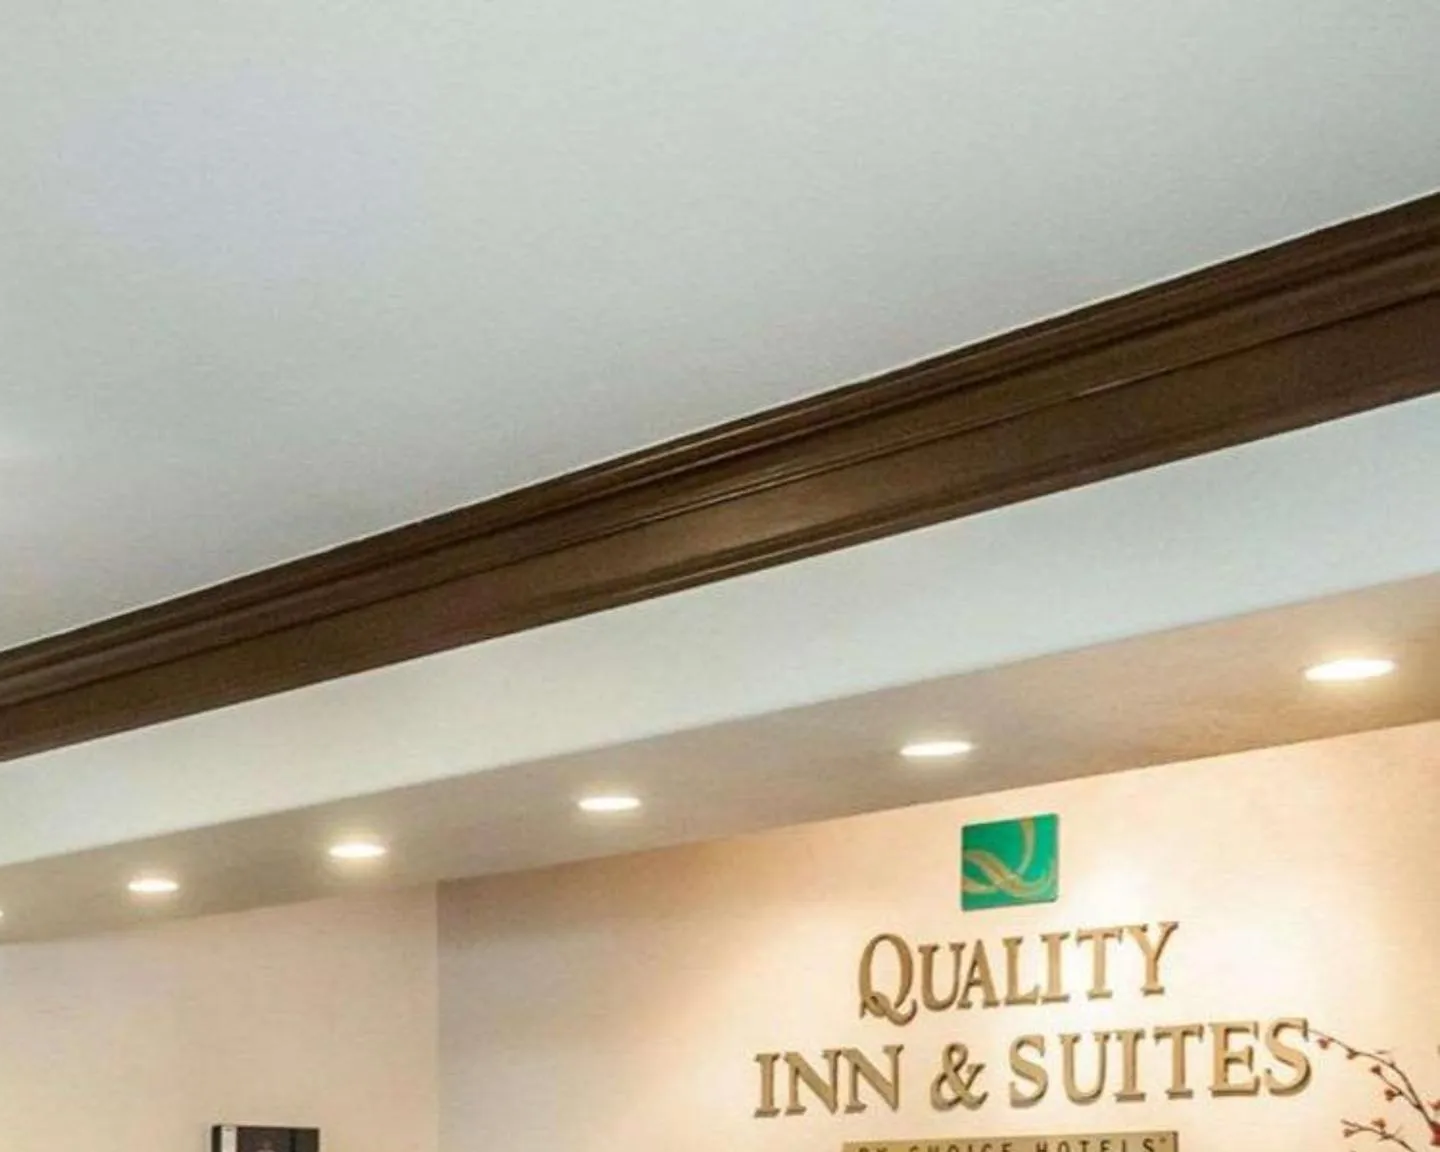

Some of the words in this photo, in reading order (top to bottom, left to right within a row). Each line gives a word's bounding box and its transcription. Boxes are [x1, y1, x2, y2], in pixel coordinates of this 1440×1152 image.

[858, 921, 1179, 1026] QUALITY
[754, 1044, 905, 1118] INN
[929, 1042, 989, 1111] &
[1008, 1017, 1314, 1109] SUITES
